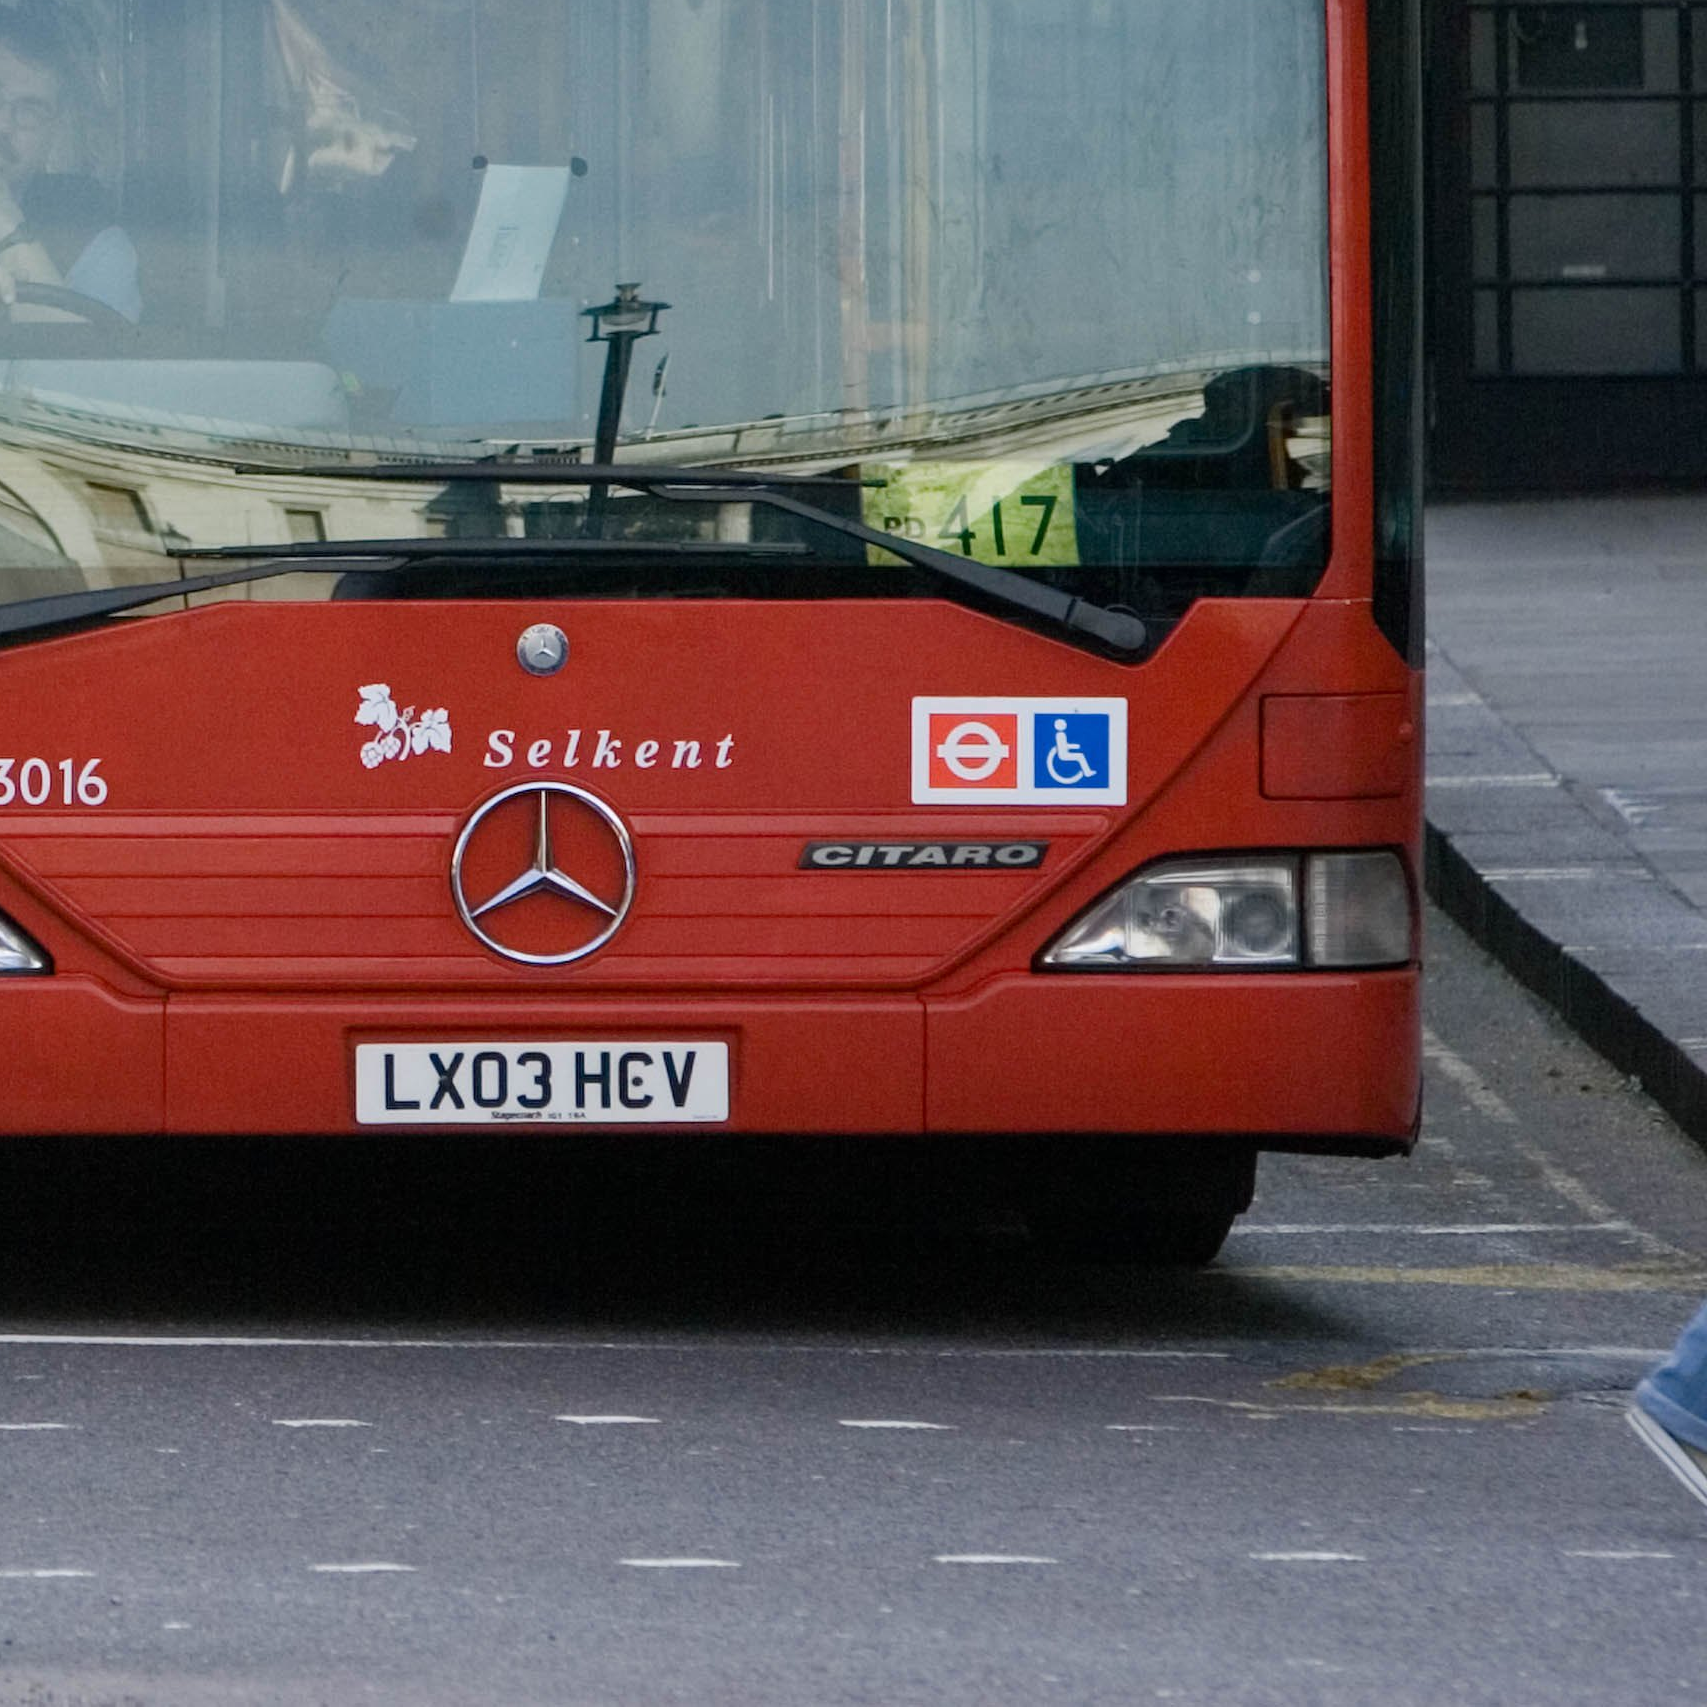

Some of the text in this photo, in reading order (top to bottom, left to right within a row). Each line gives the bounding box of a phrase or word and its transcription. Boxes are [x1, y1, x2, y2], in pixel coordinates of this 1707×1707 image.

[938, 493, 1058, 556] 417
[483, 729, 735, 769] Selkent
[811, 844, 1039, 867] CITARO
[384, 1051, 697, 1110] LX03 HCV
